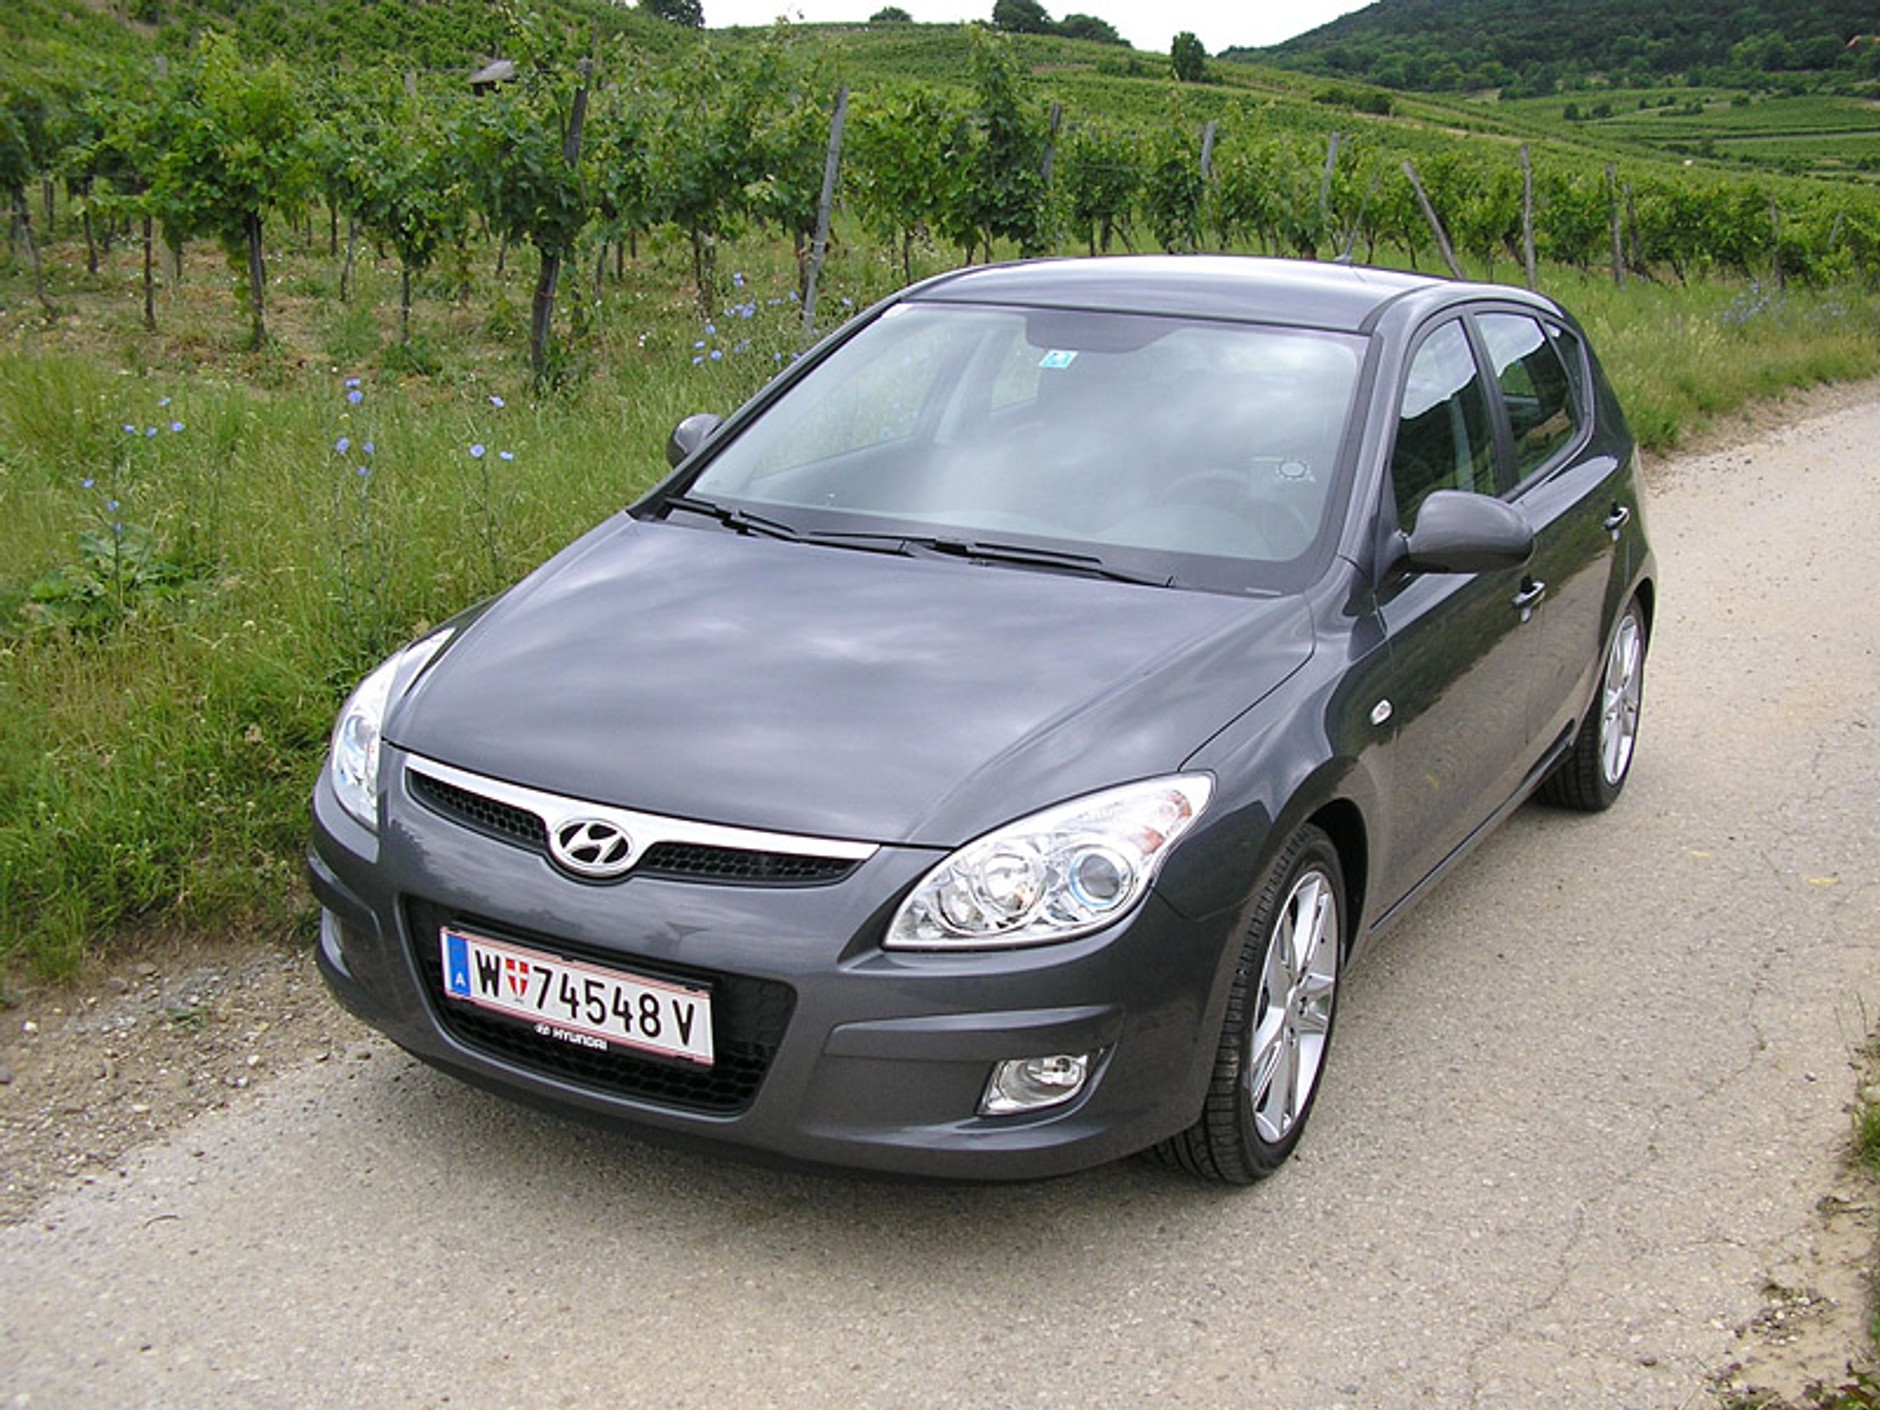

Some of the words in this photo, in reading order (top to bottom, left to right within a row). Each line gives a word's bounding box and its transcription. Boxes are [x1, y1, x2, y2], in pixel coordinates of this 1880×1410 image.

[455, 971, 467, 987] A
[475, 949, 501, 997] W
[533, 966, 662, 1038] 74548
[672, 999, 695, 1046] V
[552, 1027, 608, 1051] HYUNDAI
